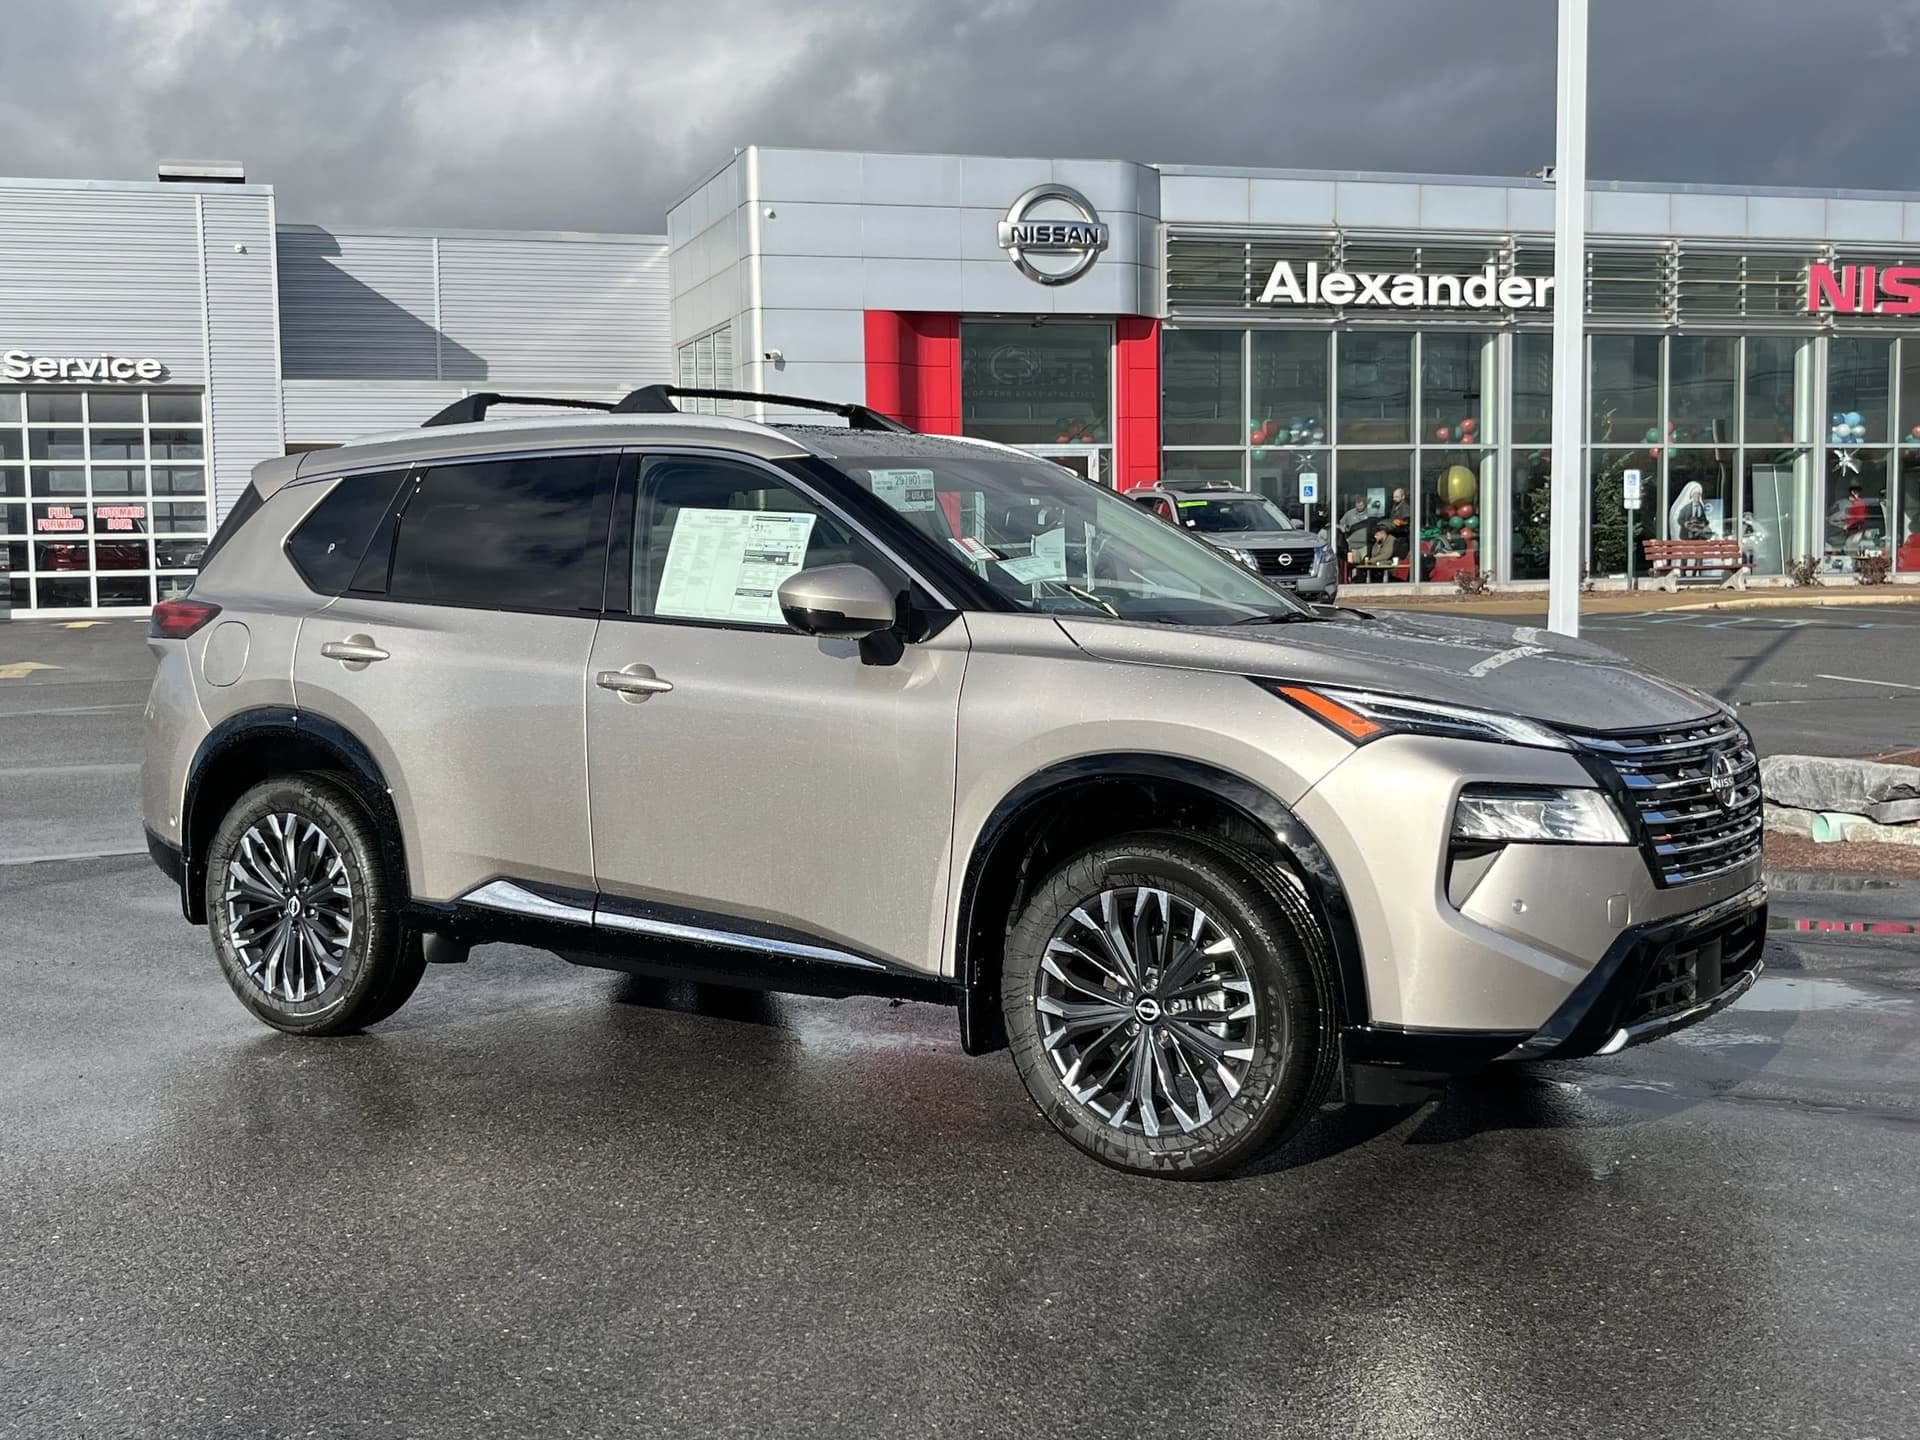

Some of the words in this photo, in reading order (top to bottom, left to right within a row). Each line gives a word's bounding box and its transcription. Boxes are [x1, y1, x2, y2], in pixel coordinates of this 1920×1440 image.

[1011, 226, 1099, 244] NISSAN
[1259, 261, 1554, 308] Alexander
[3, 350, 162, 379] Service
[48, 507, 73, 518] PULL
[97, 507, 145, 518] AUTOMATIC
[38, 519, 84, 530] FORWARD
[107, 519, 133, 530] DOOR
